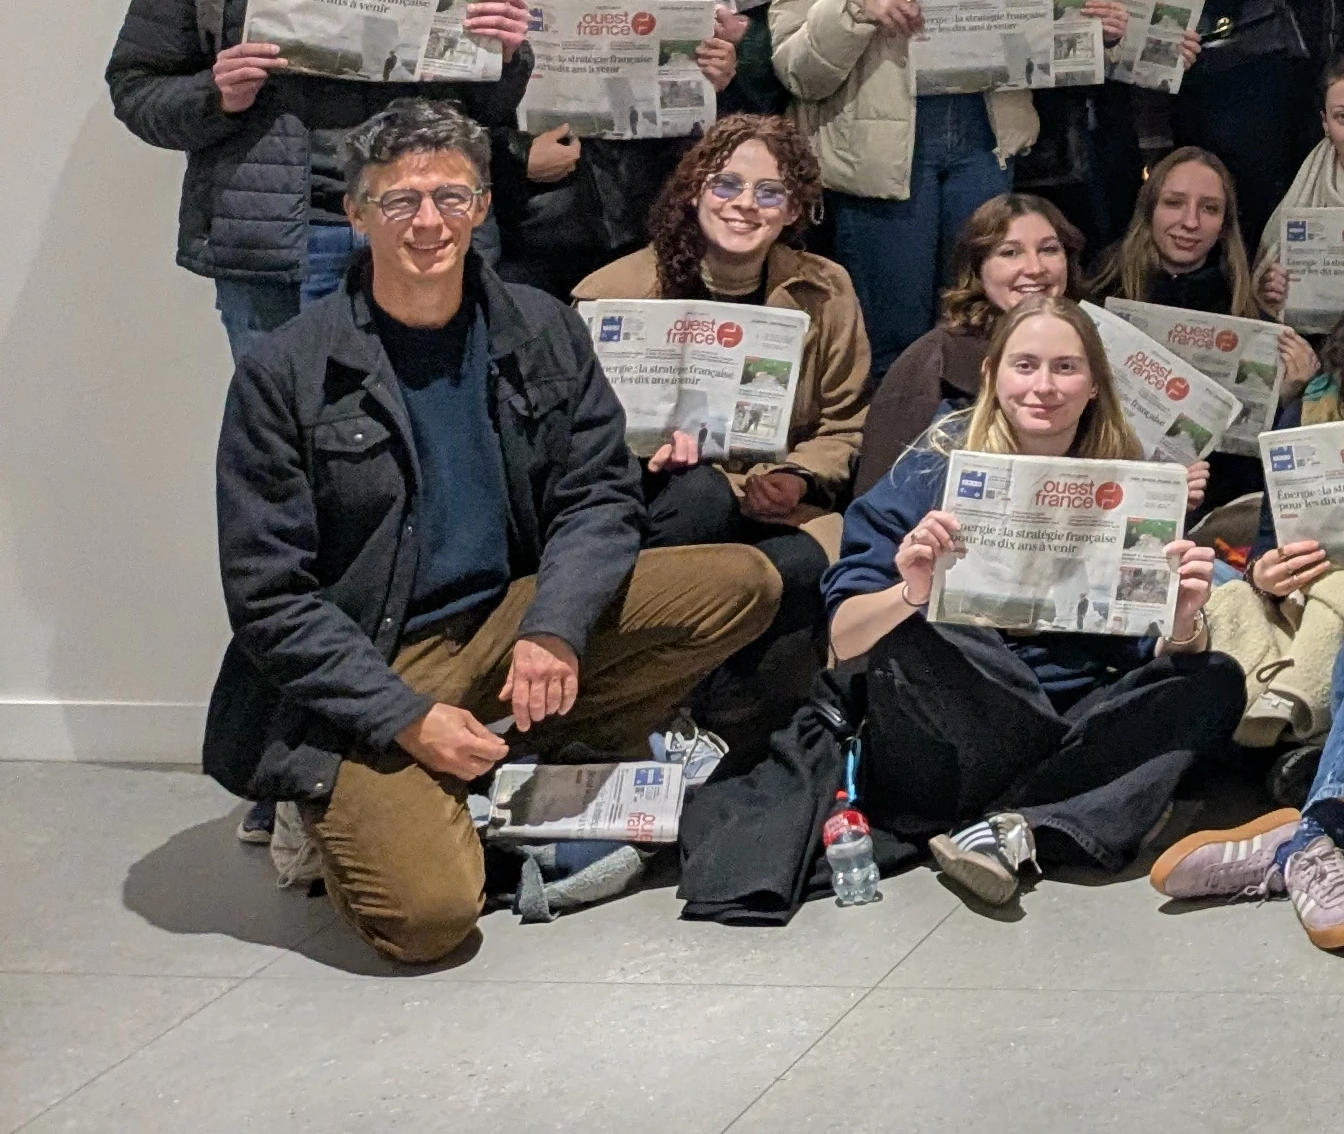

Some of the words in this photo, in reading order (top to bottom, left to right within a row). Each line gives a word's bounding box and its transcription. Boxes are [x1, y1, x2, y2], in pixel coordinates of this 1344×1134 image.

[582, 11, 629, 24] ouest
[577, 20, 631, 35] france
[674, 318, 716, 334] ouest
[667, 327, 716, 345] france
[1124, 354, 1165, 390] france
[1136, 351, 1173, 381] ouest
[1043, 480, 1095, 496] ouest
[1035, 489, 1094, 509] france
[960, 523, 996, 537] nergie
[626, 812, 646, 839] fran
[640, 814, 656, 842] oue
